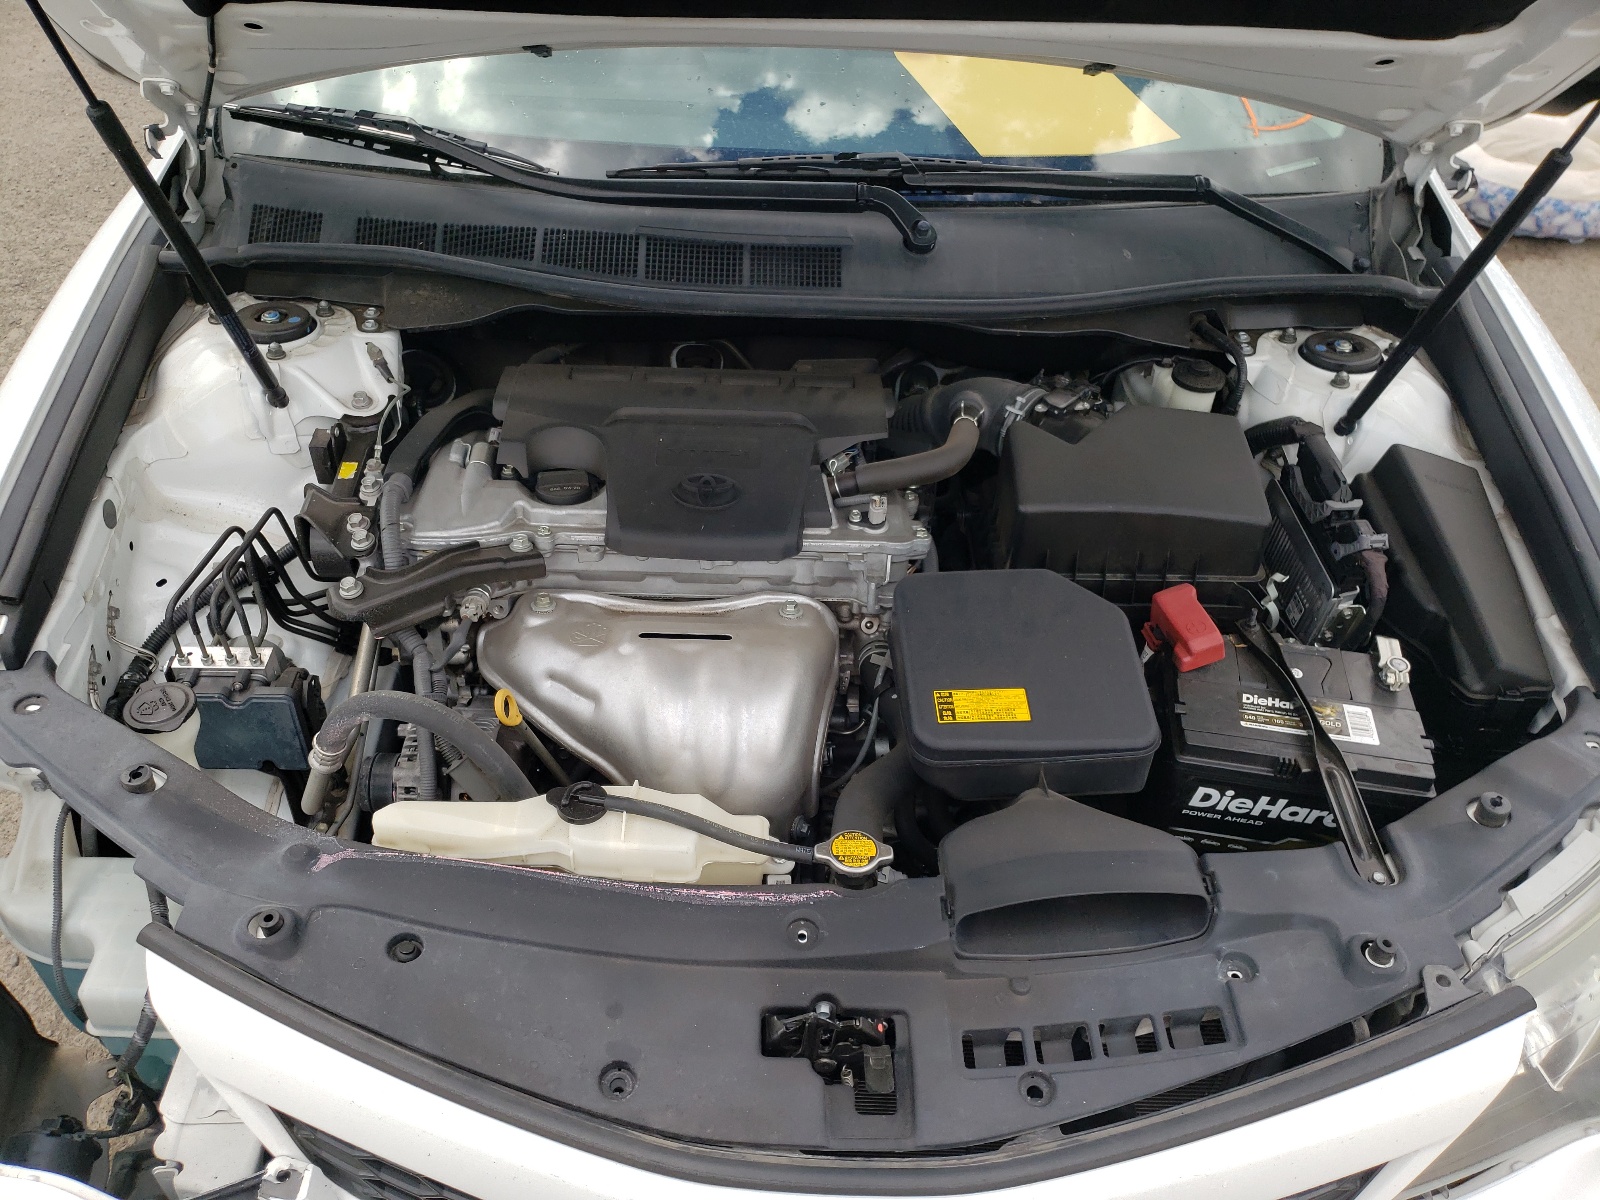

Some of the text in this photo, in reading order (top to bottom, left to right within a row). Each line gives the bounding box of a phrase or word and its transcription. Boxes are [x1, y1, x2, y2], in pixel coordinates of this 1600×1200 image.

[1242, 693, 1296, 710] DieHar
[1320, 719, 1342, 728] GOLD
[1181, 809, 1264, 826] POWER AHEAD
